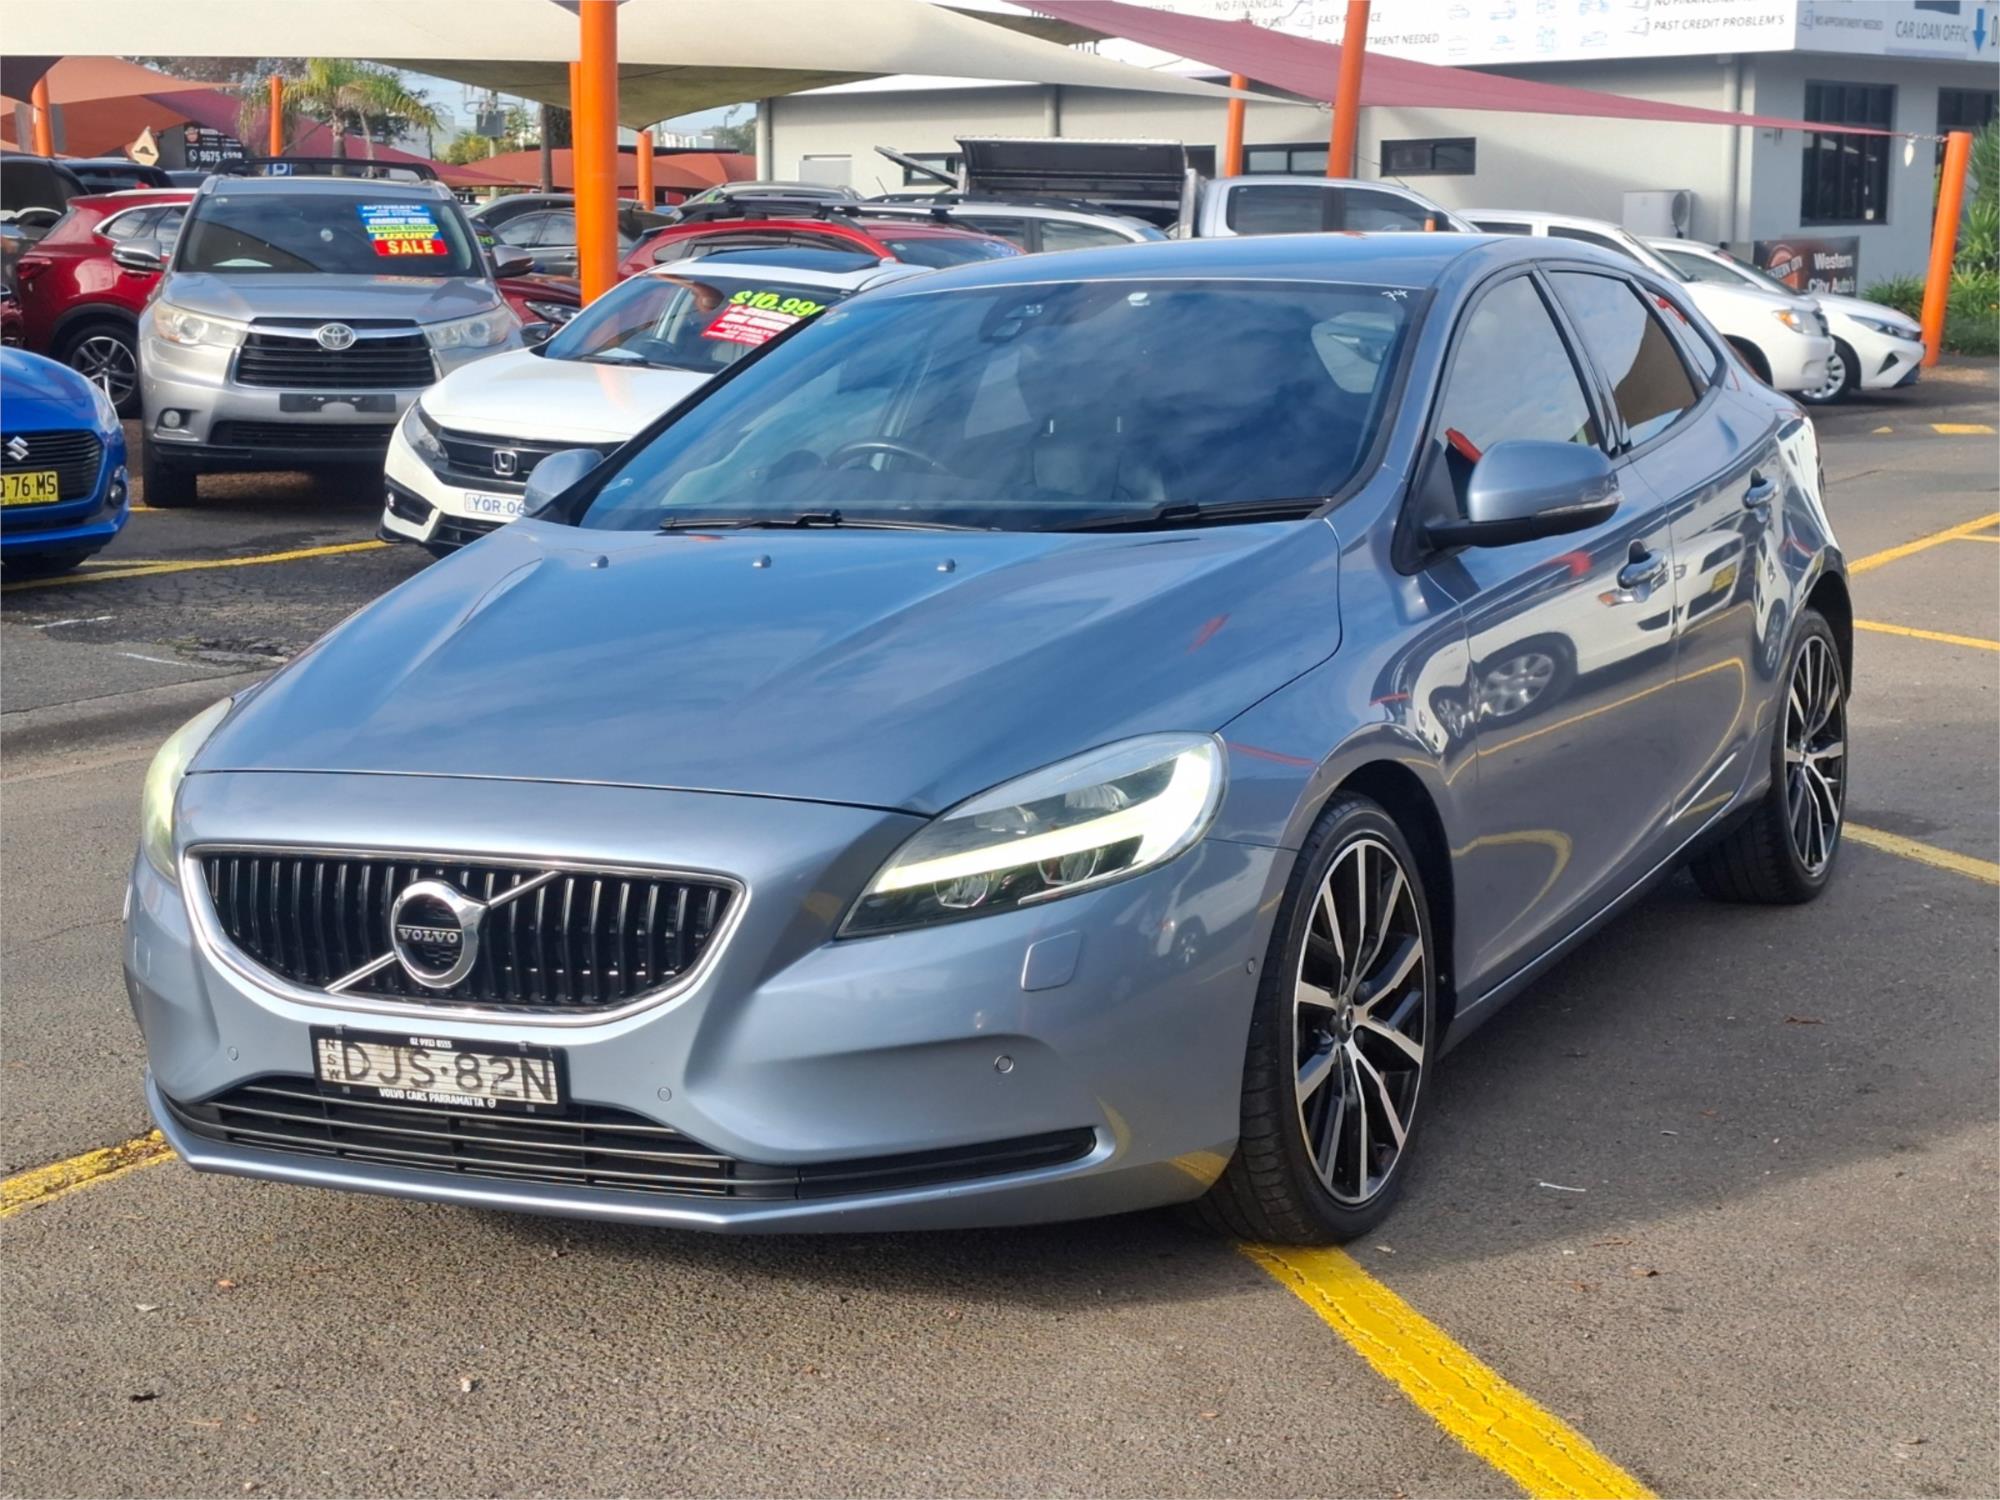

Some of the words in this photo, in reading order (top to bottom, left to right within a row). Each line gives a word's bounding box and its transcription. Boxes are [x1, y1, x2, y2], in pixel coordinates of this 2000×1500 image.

[1654, 20, 1680, 31] PAST
[1681, 18, 1720, 30] CREDIT
[1895, 20, 1914, 39] CAR
[1915, 22, 1942, 41] LOAN
[387, 240, 435, 255] SALE
[1813, 252, 1853, 271] Western
[397, 928, 458, 943] VOLVO
[379, 1087, 404, 1100] VOLVO
[405, 1090, 428, 1102] CARS
[428, 1093, 485, 1107] PARRAMATTA
